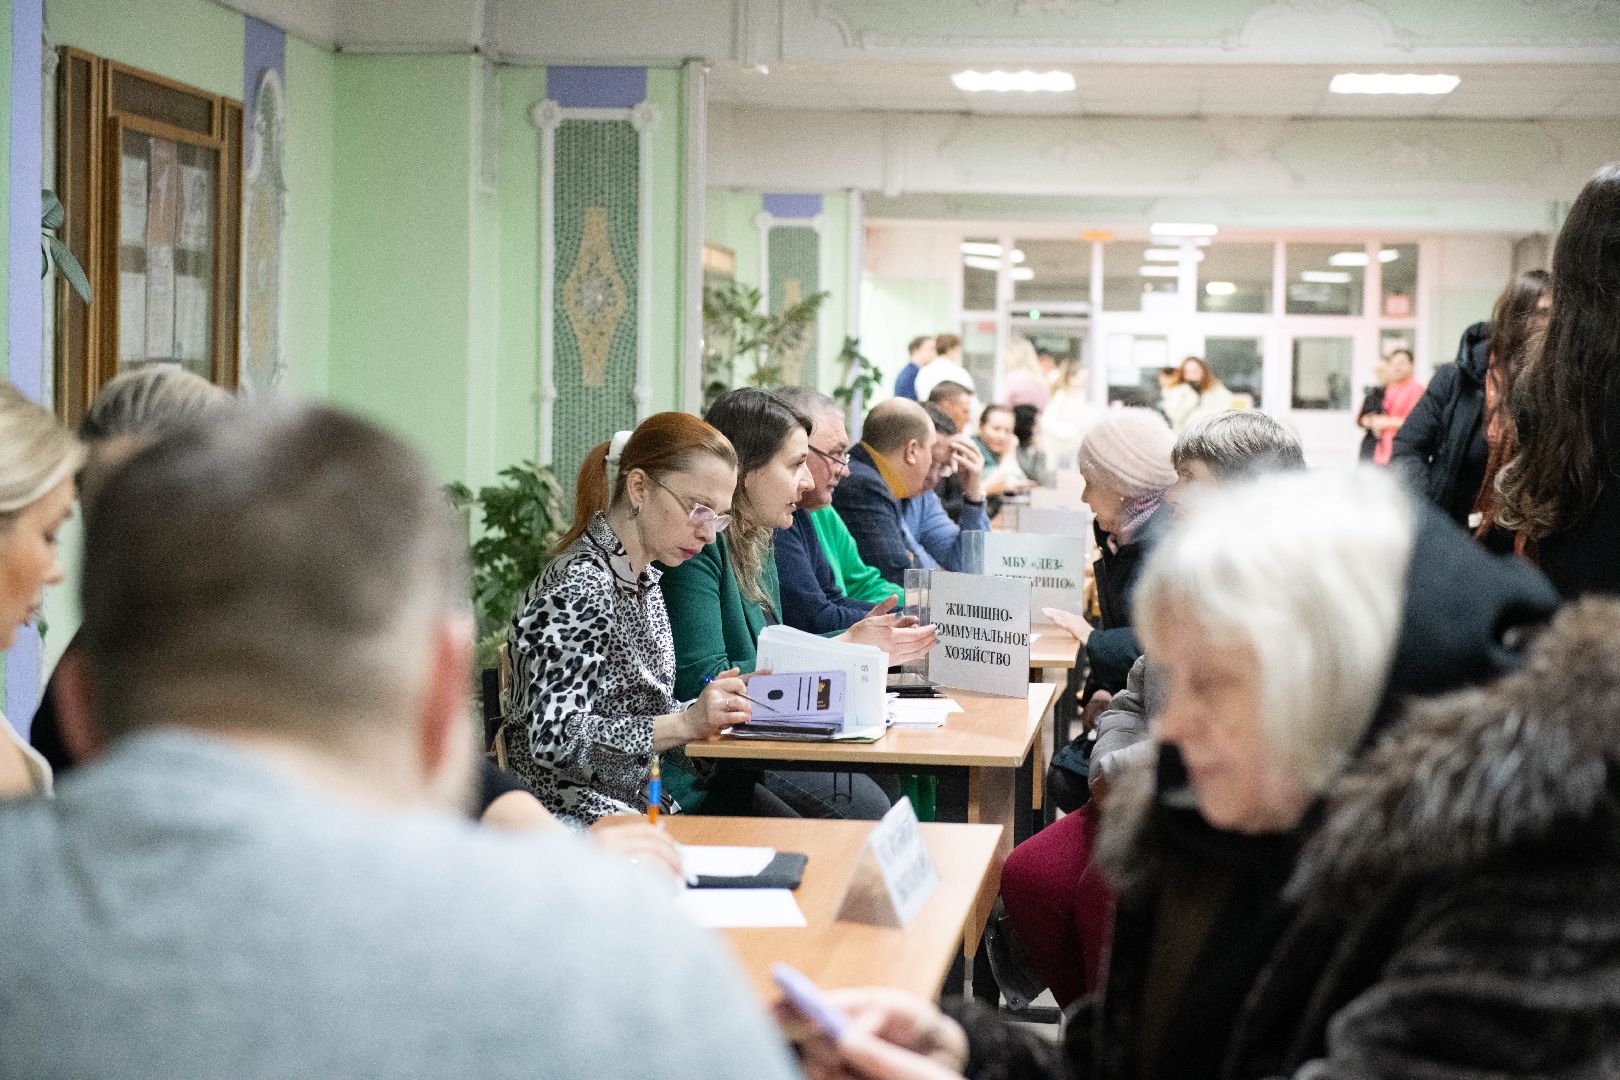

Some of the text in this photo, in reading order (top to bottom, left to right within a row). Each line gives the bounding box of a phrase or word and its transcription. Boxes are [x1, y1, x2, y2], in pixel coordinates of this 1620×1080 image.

[1002, 556, 1026, 568] МБУ
[945, 602, 1013, 622] ЖИЛИЩНО-
[944, 645, 1011, 667] ХОЗЯЙСТВО
